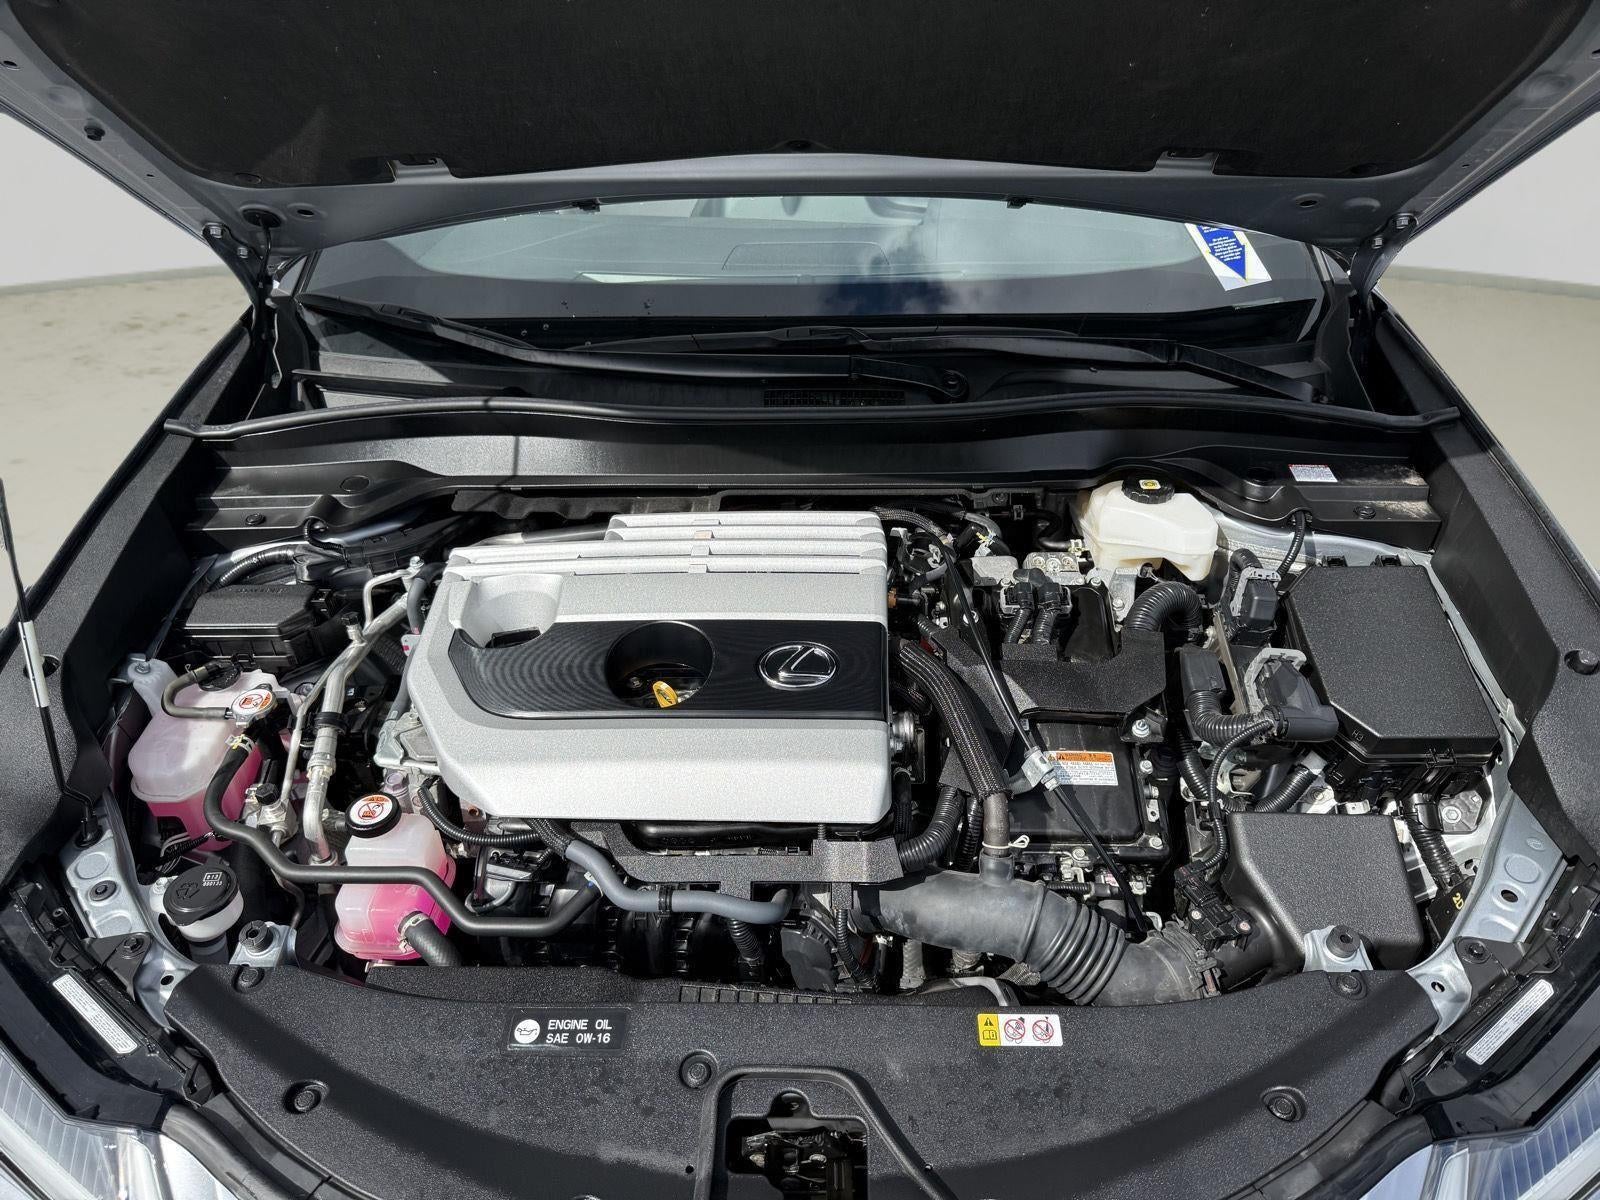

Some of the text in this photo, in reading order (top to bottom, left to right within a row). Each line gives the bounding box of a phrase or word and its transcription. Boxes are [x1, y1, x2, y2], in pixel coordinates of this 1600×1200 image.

[547, 1019, 613, 1030] ENGINE OIL
[545, 1033, 611, 1044] SAE 0W-16
